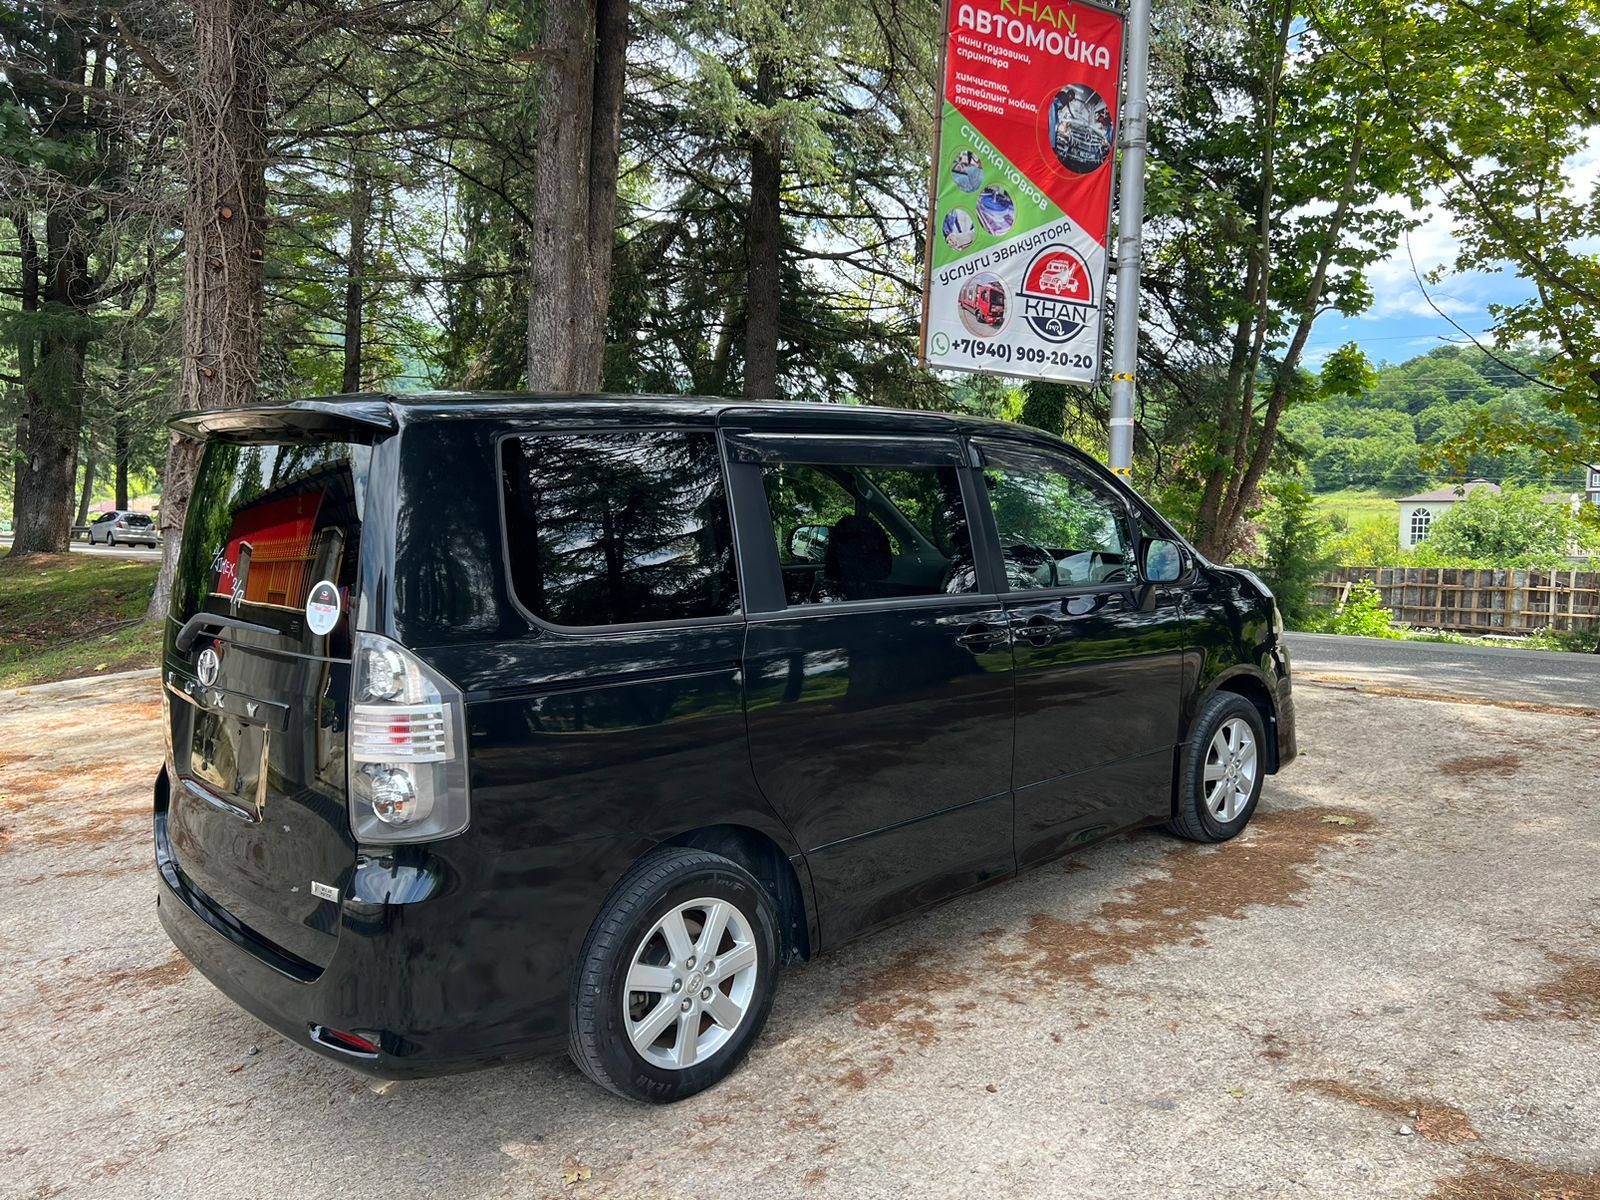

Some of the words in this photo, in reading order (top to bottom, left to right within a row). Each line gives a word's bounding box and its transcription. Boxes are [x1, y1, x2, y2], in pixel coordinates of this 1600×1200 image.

[1000, 0, 1076, 33] KHAN
[958, 4, 1110, 70] АВТОМОЙКА
[956, 47, 1009, 69] спринтера
[955, 72, 1010, 94] химчистка,
[955, 96, 1004, 115] полировка
[1008, 97, 1038, 113] мойка,
[960, 124, 1005, 170] СТИРКА
[1003, 167, 1048, 211] КОВРОВ
[939, 254, 990, 286] УСЛУГИ
[993, 222, 1072, 263] ЭВАКУАТОРА
[1025, 298, 1087, 323] KHAN
[952, 338, 1012, 363] +7(940)
[1016, 346, 1093, 369] 909-20-20
